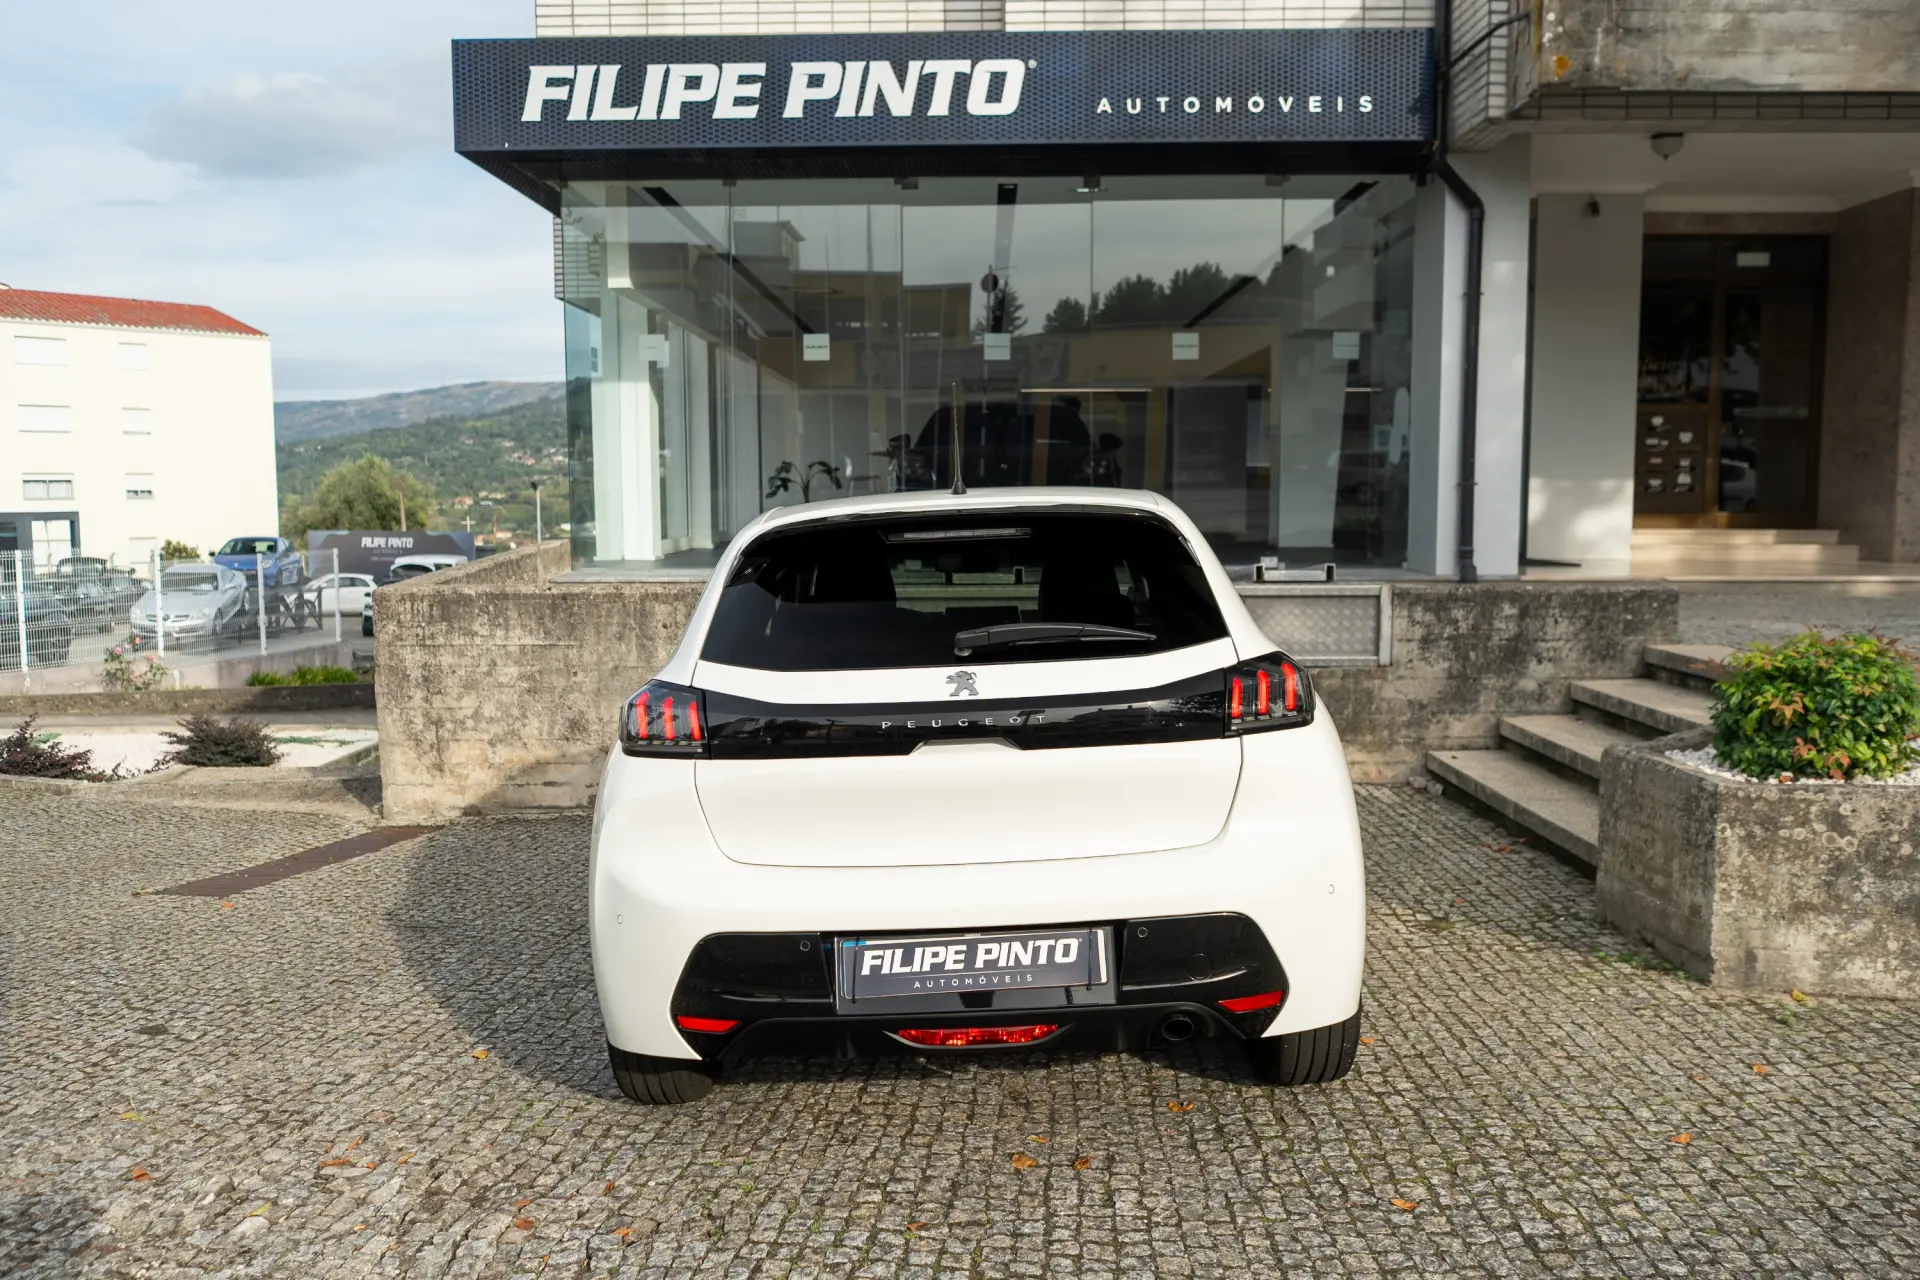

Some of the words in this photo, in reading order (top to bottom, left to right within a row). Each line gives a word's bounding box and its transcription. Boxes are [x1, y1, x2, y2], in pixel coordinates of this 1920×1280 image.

[521, 61, 767, 121] FILIPE
[782, 58, 1026, 118] PINTO
[361, 537, 387, 548] FILIPE
[388, 537, 413, 548] PINTO
[881, 715, 1045, 730] PEUGEOT
[861, 945, 966, 975] FILIPE
[975, 938, 1079, 969] PINTO
[914, 974, 1033, 989] AUTOMÓVEIS
